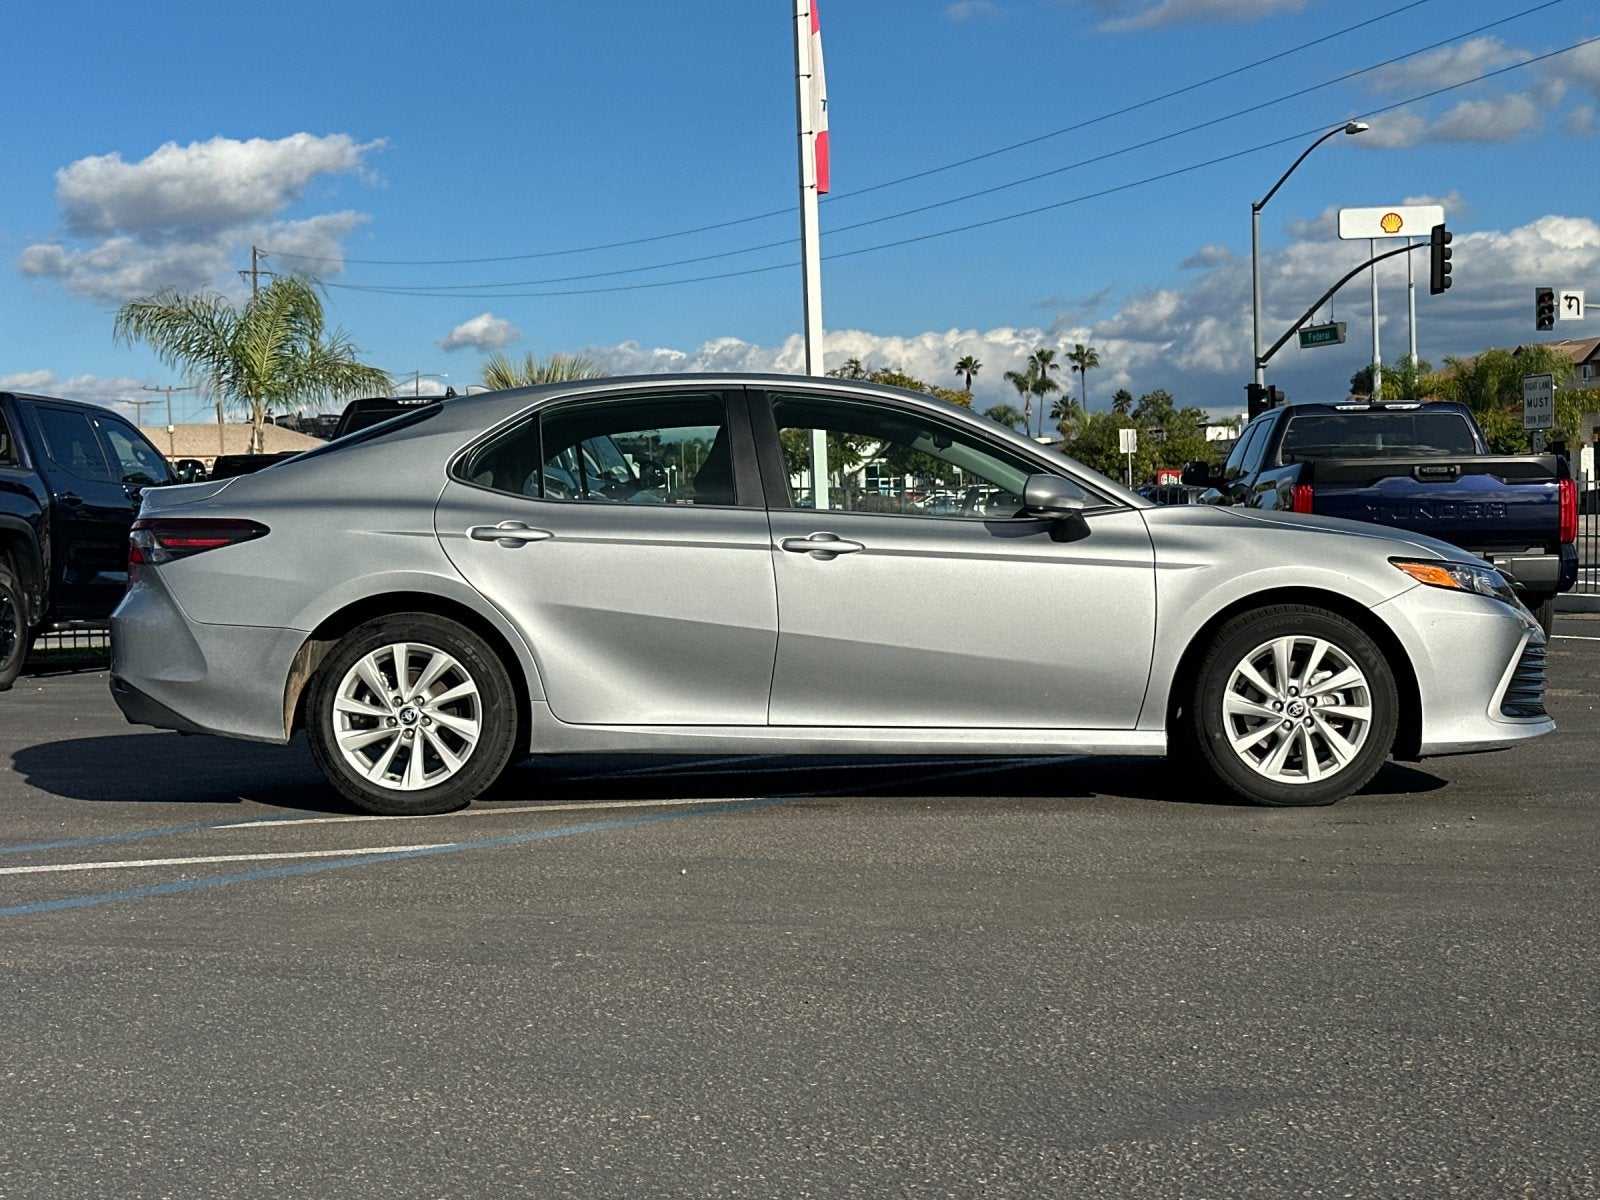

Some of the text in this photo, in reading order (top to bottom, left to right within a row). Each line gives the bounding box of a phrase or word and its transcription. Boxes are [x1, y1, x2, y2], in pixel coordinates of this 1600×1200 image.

[1308, 331, 1330, 342] Federal
[1525, 381, 1551, 391] RIGHT LANE
[1526, 397, 1549, 408] MUST
[1525, 414, 1551, 424] TURN RIGHT
[1363, 503, 1508, 520] TUNDRA
[1256, 617, 1304, 633] KUMHO
